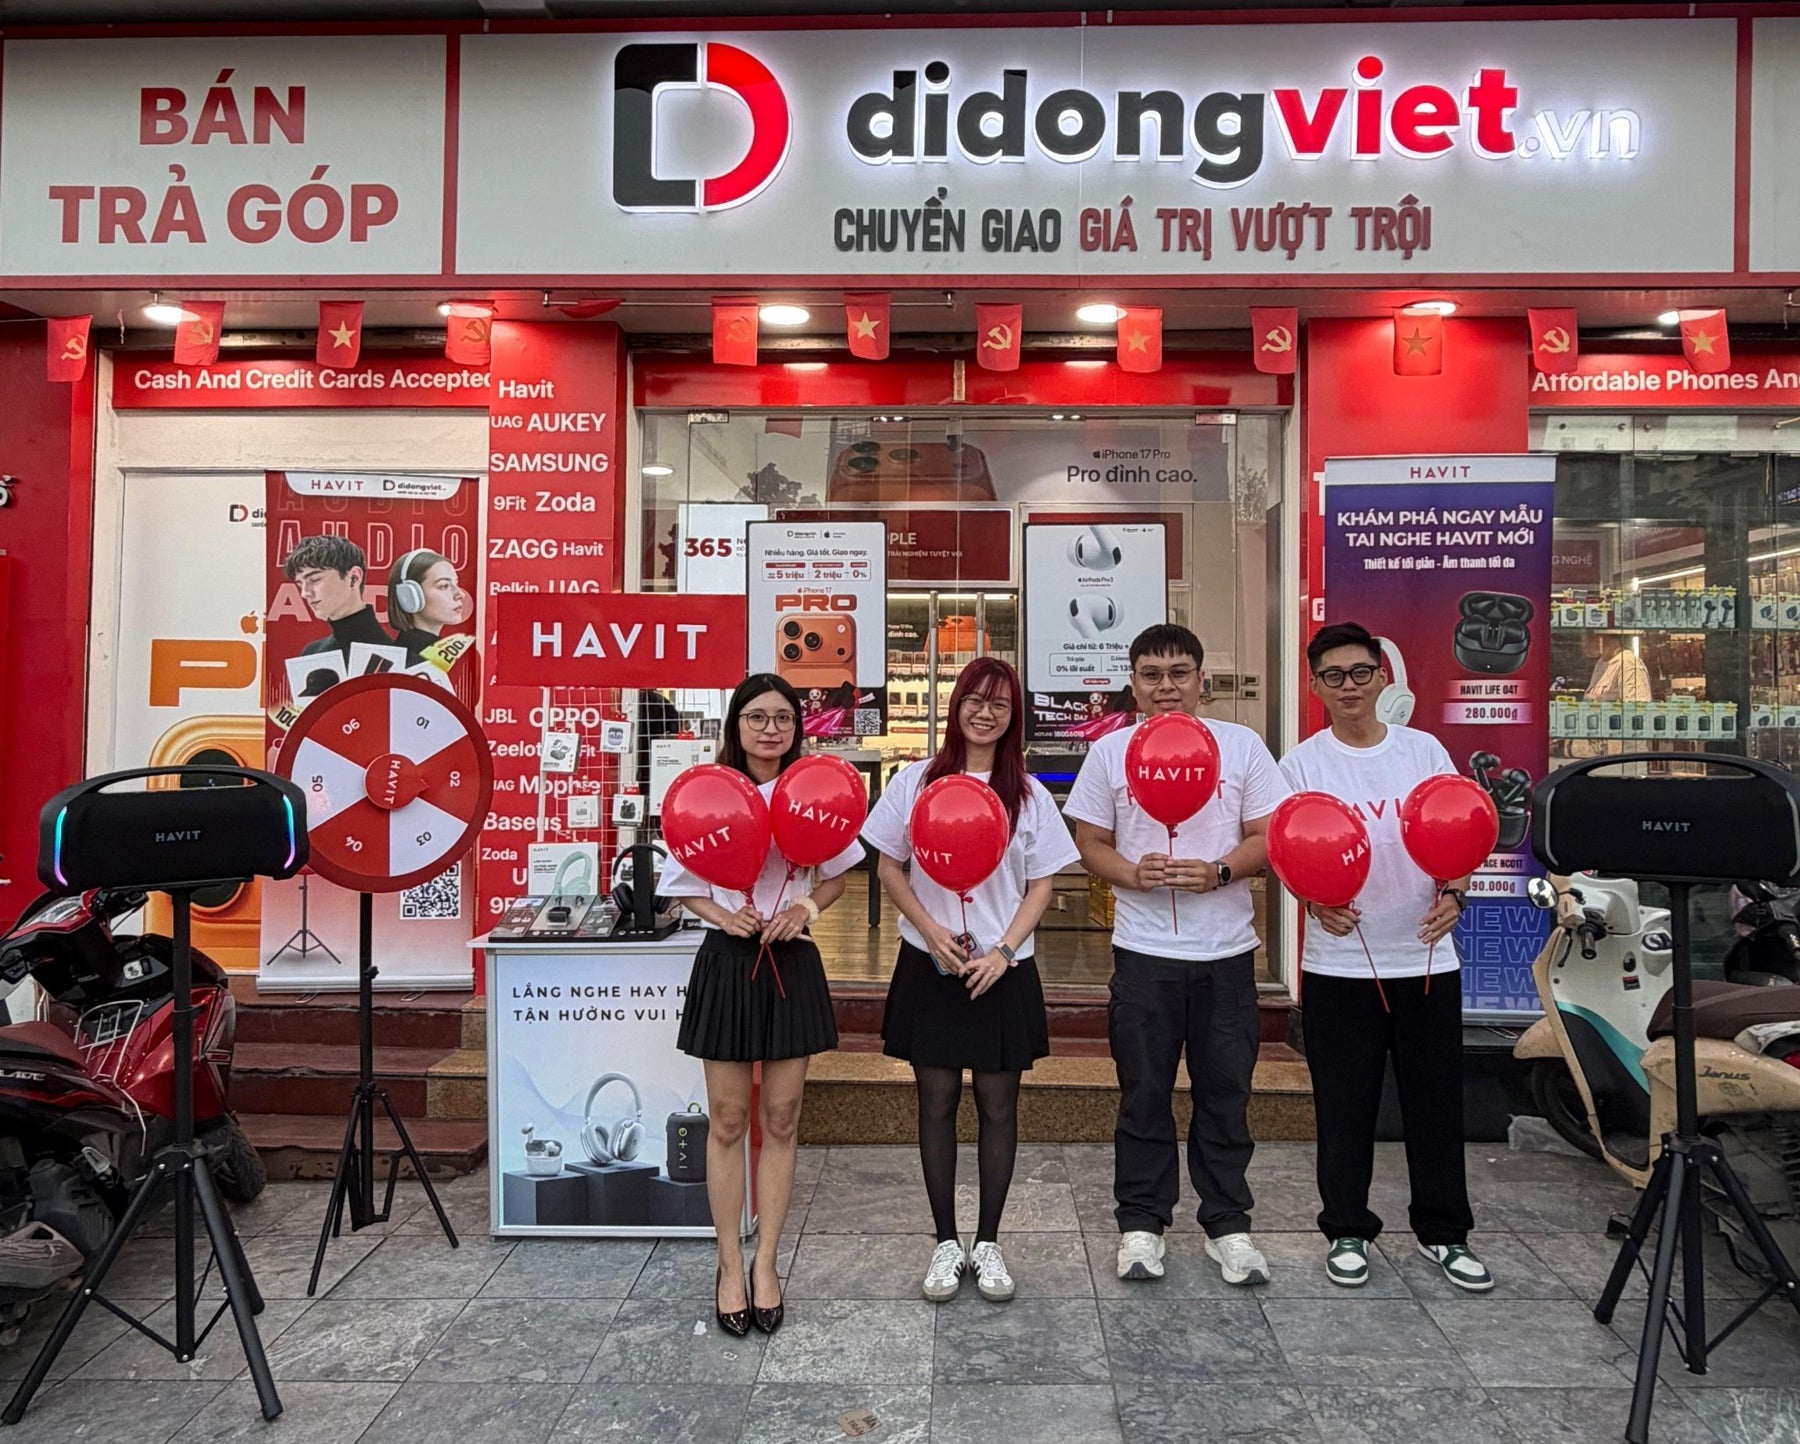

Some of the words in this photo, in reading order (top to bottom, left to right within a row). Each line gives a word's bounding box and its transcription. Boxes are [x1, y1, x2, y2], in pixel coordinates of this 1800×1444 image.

[138, 68, 306, 146] BÁN
[48, 164, 208, 245] TRẢ
[226, 165, 399, 244] GÓP
[834, 187, 966, 252] CHUYỂN
[981, 208, 1061, 252] GIAO
[1079, 195, 1138, 252] GIÁ
[1156, 207, 1212, 260] TRỊ
[1231, 202, 1333, 260] VƯỢT
[1350, 194, 1432, 260] TRỘI
[134, 369, 191, 389] Cash
[195, 368, 241, 389] And
[246, 368, 314, 389] Credit
[319, 368, 385, 389] Cards
[1531, 369, 1661, 392] Affordable
[1666, 368, 1758, 391] Phones
[1763, 367, 1800, 390] An
[499, 380, 554, 398] Havit
[491, 415, 523, 428] UAG
[527, 413, 606, 432] AUKEY
[490, 453, 609, 472] SAMSUNG
[1102, 449, 1138, 460] iPhone
[1141, 449, 1151, 459] 17
[1153, 449, 1171, 459] Pro
[1066, 465, 1101, 483] Pro
[1105, 462, 1150, 483] đỉnh
[1155, 468, 1198, 483] cao.
[1410, 466, 1471, 478] HAVIT
[312, 479, 364, 491] HAVIT
[494, 496, 526, 511] 9Fit
[535, 491, 596, 512] Zoda
[1337, 508, 1394, 526] KHÁM
[1399, 507, 1438, 525] PHÁ
[1443, 509, 1495, 524] NGAY
[1500, 504, 1543, 524] MẪU
[1345, 532, 1375, 547] TAI
[1380, 531, 1432, 546] NGHE
[1436, 530, 1493, 545] HAVIT
[1497, 527, 1534, 545] MỚI
[489, 539, 558, 559] ZAGG
[562, 541, 604, 556] Havit
[684, 538, 732, 557] 365
[1364, 555, 1386, 569] Thiết
[1460, 556, 1487, 568] thanh
[490, 581, 539, 596] Belkin
[775, 594, 857, 611] PRO
[532, 622, 707, 660] HAVIT
[1460, 684, 1482, 696] HAVIT
[1485, 684, 1500, 695] LIFE
[1034, 693, 1088, 712] BLACK
[416, 716, 429, 730] 01
[485, 709, 517, 723] JBL
[529, 707, 600, 728] OPPO
[1034, 710, 1072, 721] TECH
[342, 718, 361, 736] 06
[312, 775, 323, 792] 05
[384, 760, 401, 804] HAVIT
[449, 771, 461, 787] 02
[1138, 766, 1205, 782] HAVIT
[483, 812, 562, 832] Baseus
[788, 800, 850, 832] HAVIT
[155, 830, 201, 842] HAVIT
[1642, 821, 1691, 833] HAVIT
[345, 836, 363, 852] 04
[416, 831, 432, 846] 03
[673, 826, 730, 861] HAVIT
[482, 848, 518, 861] Zoda
[1453, 906, 1544, 932] NEW
[513, 982, 561, 998] LẮNG
[570, 986, 621, 998] NGHE
[630, 986, 667, 997] HAY
[514, 1005, 549, 1025] TẬN
[559, 1005, 625, 1021] HƯỞNG
[635, 1009, 666, 1021] VUI
